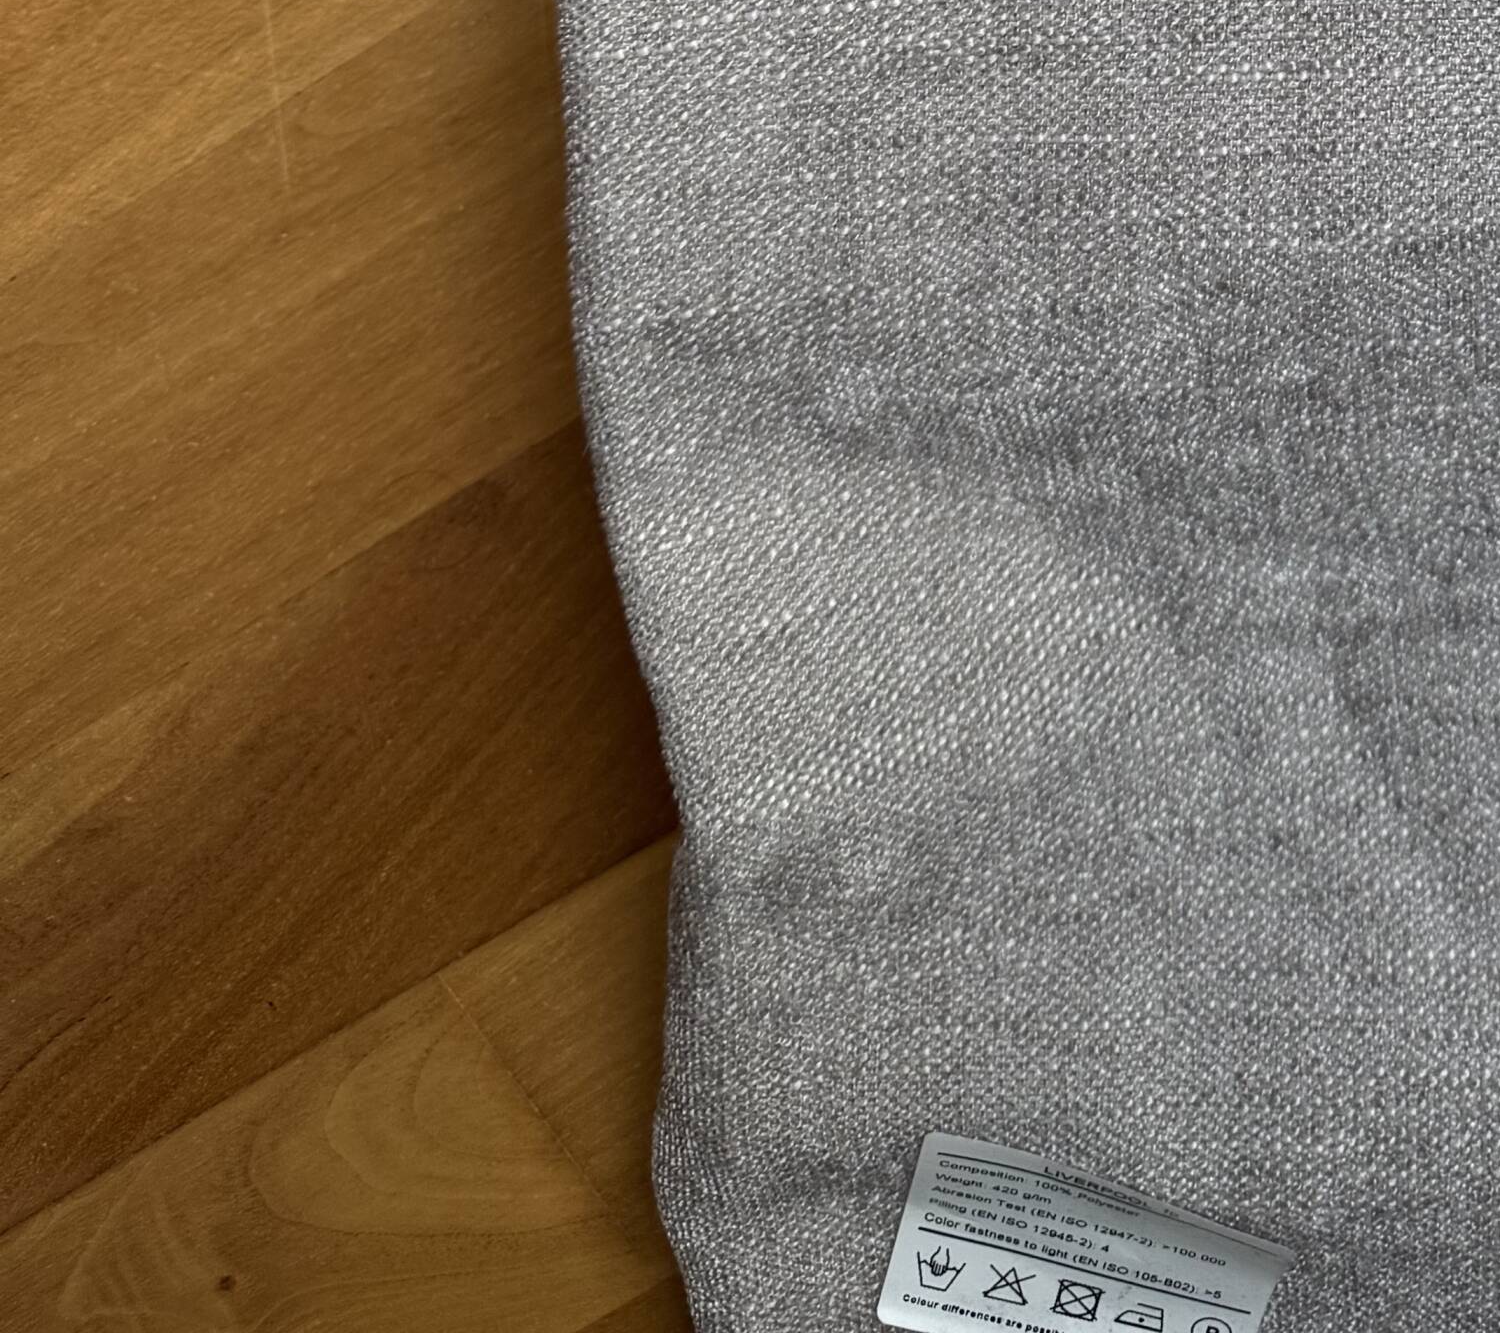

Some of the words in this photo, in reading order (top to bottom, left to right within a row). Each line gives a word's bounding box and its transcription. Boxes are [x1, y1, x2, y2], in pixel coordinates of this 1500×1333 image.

[931, 1185, 992, 1204] Abrasion
[996, 1198, 1026, 1213] Test
[1030, 1207, 1057, 1221] (EN
[1060, 1215, 1088, 1229] ISO
[992, 1185, 1019, 1196] 420
[1034, 1179, 1072, 1195] 100%
[1077, 1192, 1141, 1217] Polyester
[924, 1212, 961, 1229] Color
[964, 1222, 1020, 1245] fastness
[1024, 1240, 1038, 1251] to
[1041, 1244, 1068, 1260] light
[1072, 1254, 1099, 1268] (EN
[1102, 1261, 1129, 1275] ISO
[928, 1197, 967, 1214] Pilling
[971, 1208, 998, 1221] (EN
[1001, 1216, 1028, 1229] ISO
[1100, 1244, 1110, 1253] 4
[902, 1293, 940, 1310] Colour
[941, 1303, 1002, 1326] differences
[1005, 1318, 1023, 1330] are
